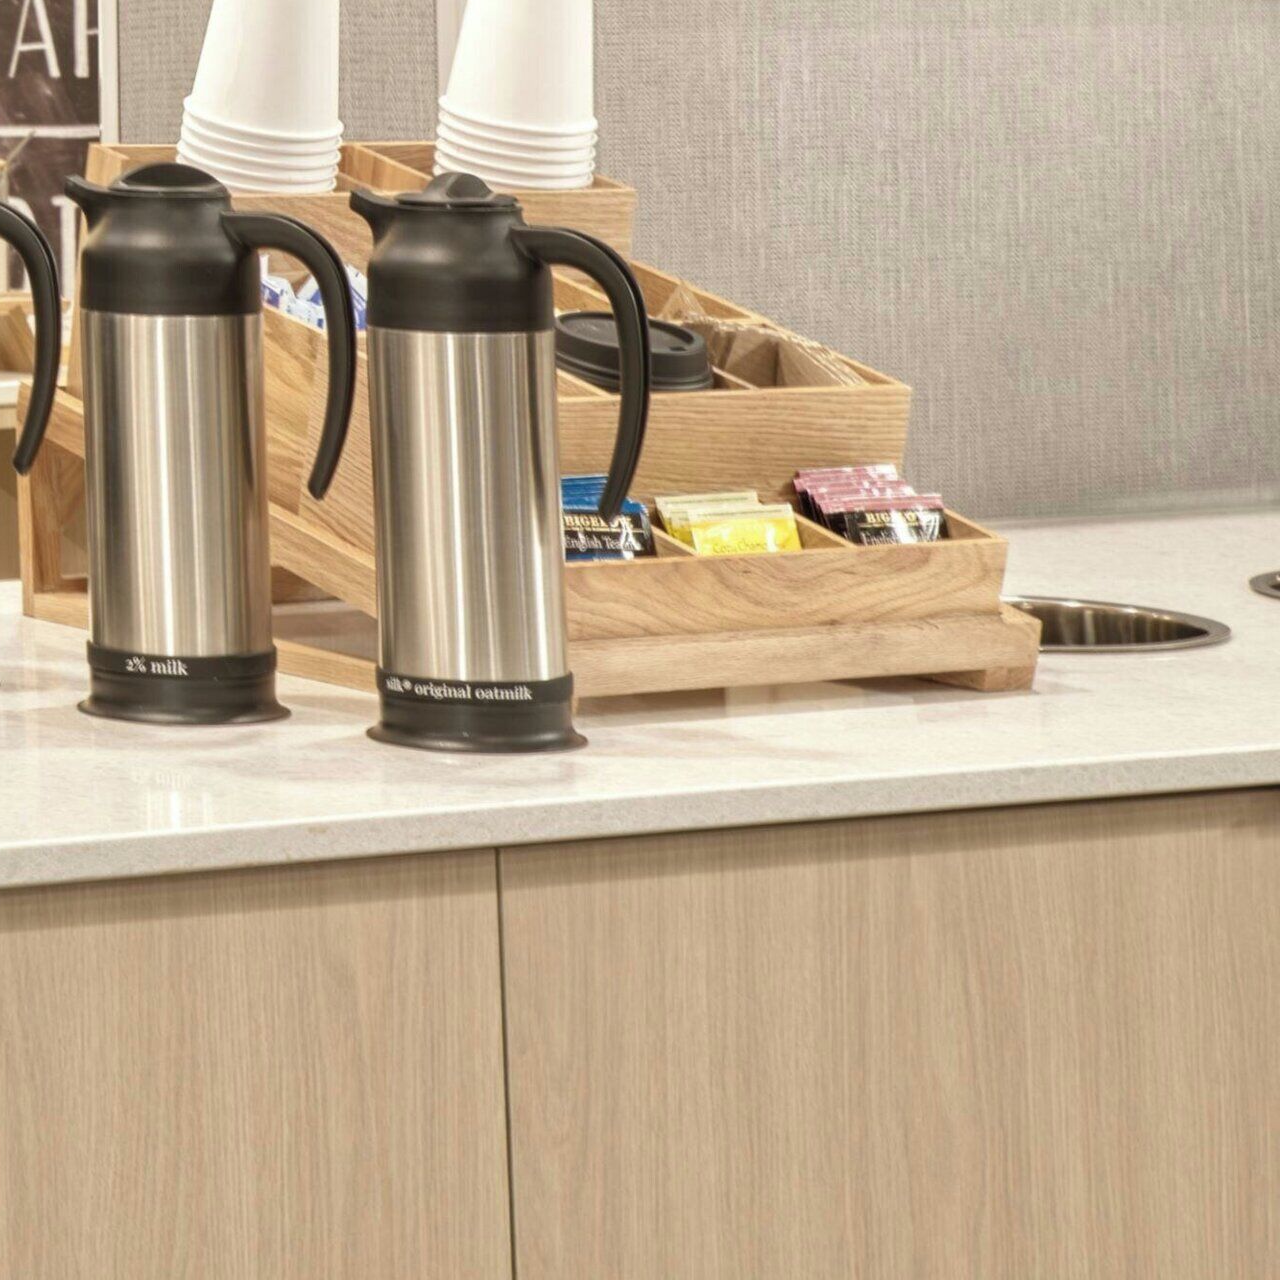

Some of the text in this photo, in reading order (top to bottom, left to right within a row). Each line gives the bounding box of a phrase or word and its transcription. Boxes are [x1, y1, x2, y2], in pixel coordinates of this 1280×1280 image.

[125, 655, 189, 676] 2% milk
[414, 681, 472, 699] original
[475, 685, 534, 701] oatmilk
